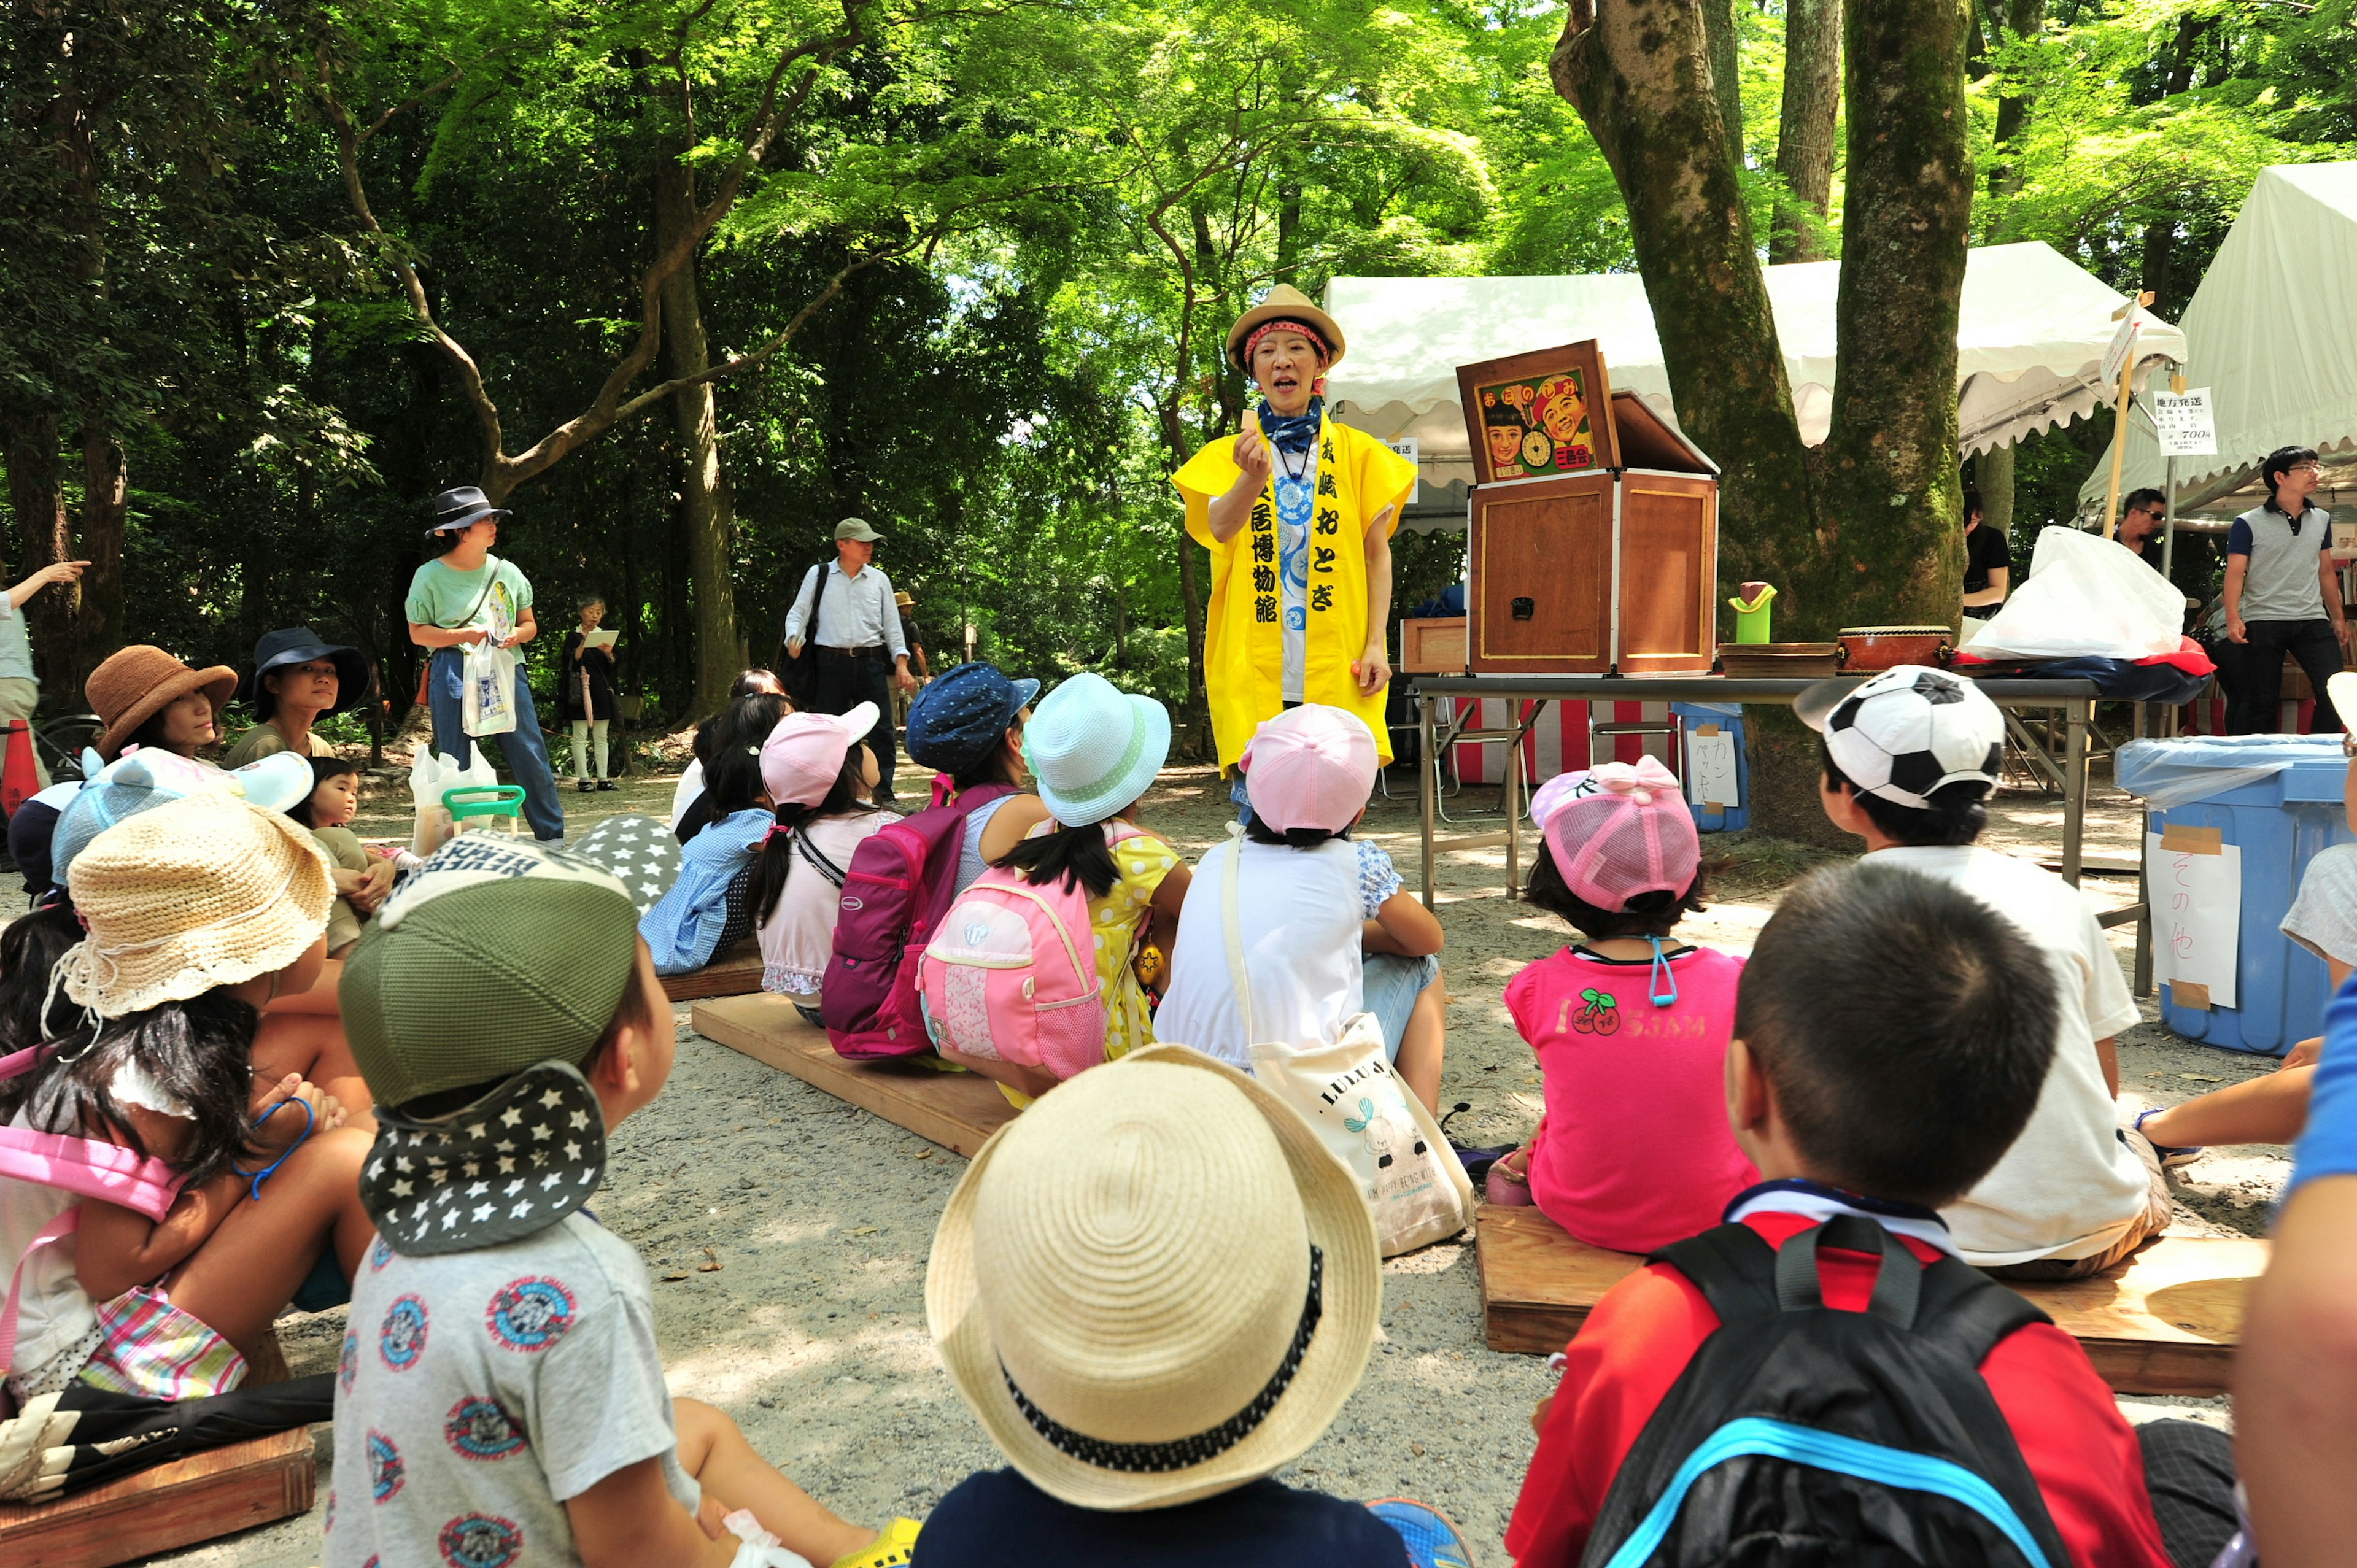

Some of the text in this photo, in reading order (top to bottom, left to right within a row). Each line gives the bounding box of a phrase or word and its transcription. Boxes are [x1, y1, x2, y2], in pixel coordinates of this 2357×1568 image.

[1484, 380, 1576, 407] おたのしみ
[2156, 396, 2202, 407] 地方発送
[1712, 740, 1728, 778] カン
[2170, 854, 2193, 959] その他
[1321, 1065, 1370, 1106] LULU
[1400, 1172, 1418, 1189] BEING
